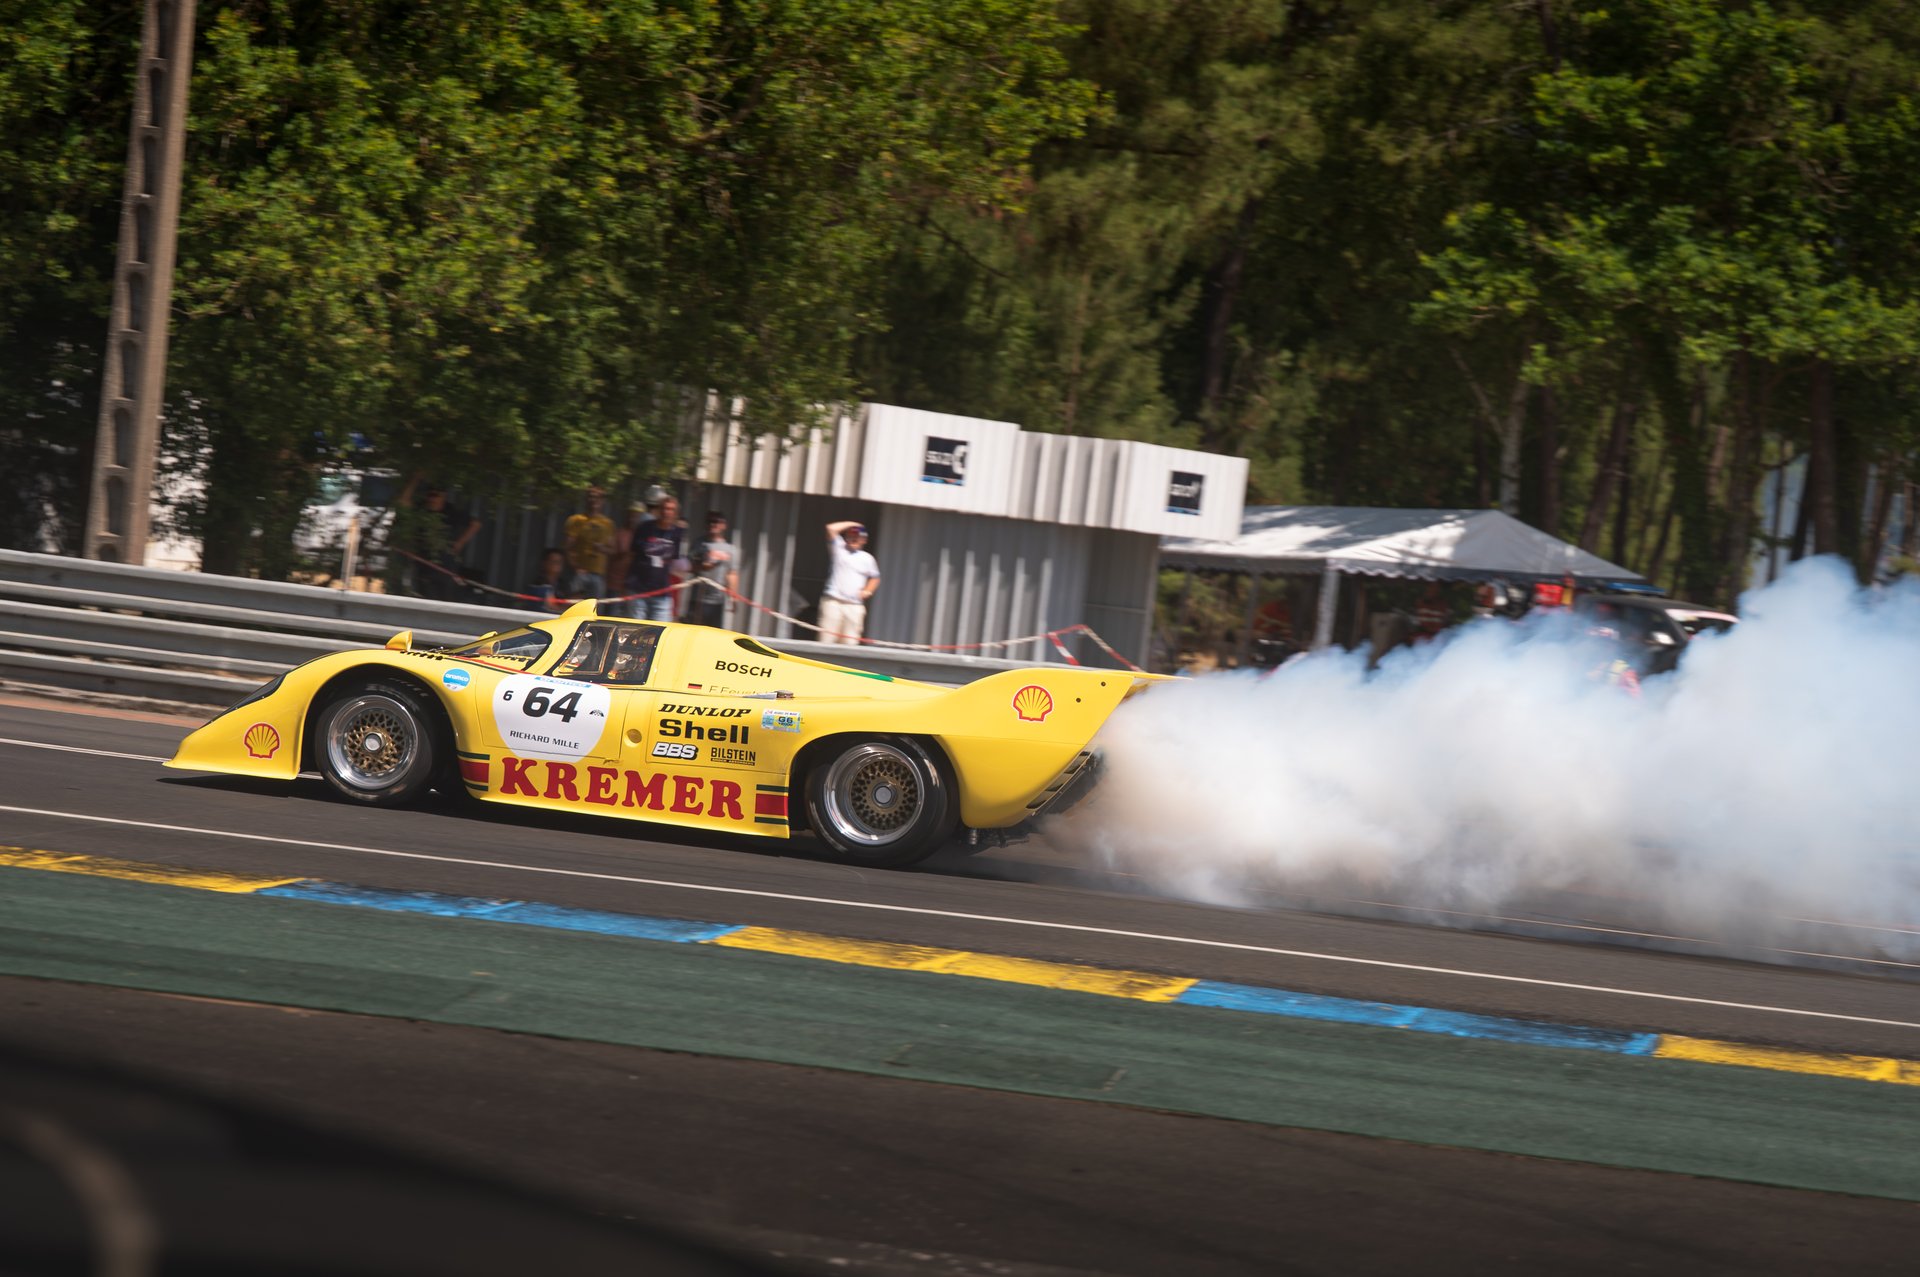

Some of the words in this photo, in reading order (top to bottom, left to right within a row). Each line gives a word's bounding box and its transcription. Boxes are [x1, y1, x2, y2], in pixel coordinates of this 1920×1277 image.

[445, 673, 469, 682] aramco
[715, 660, 773, 678] BOSCH
[503, 690, 514, 701] 6
[522, 686, 583, 723] 64
[658, 703, 751, 718] DUNLOP
[510, 730, 550, 743] RICHARD
[552, 738, 580, 749] MILLE
[659, 718, 749, 744] Shell
[652, 741, 698, 760] BBS
[711, 747, 756, 761] BILSTEIN
[500, 758, 744, 820] KREMER
